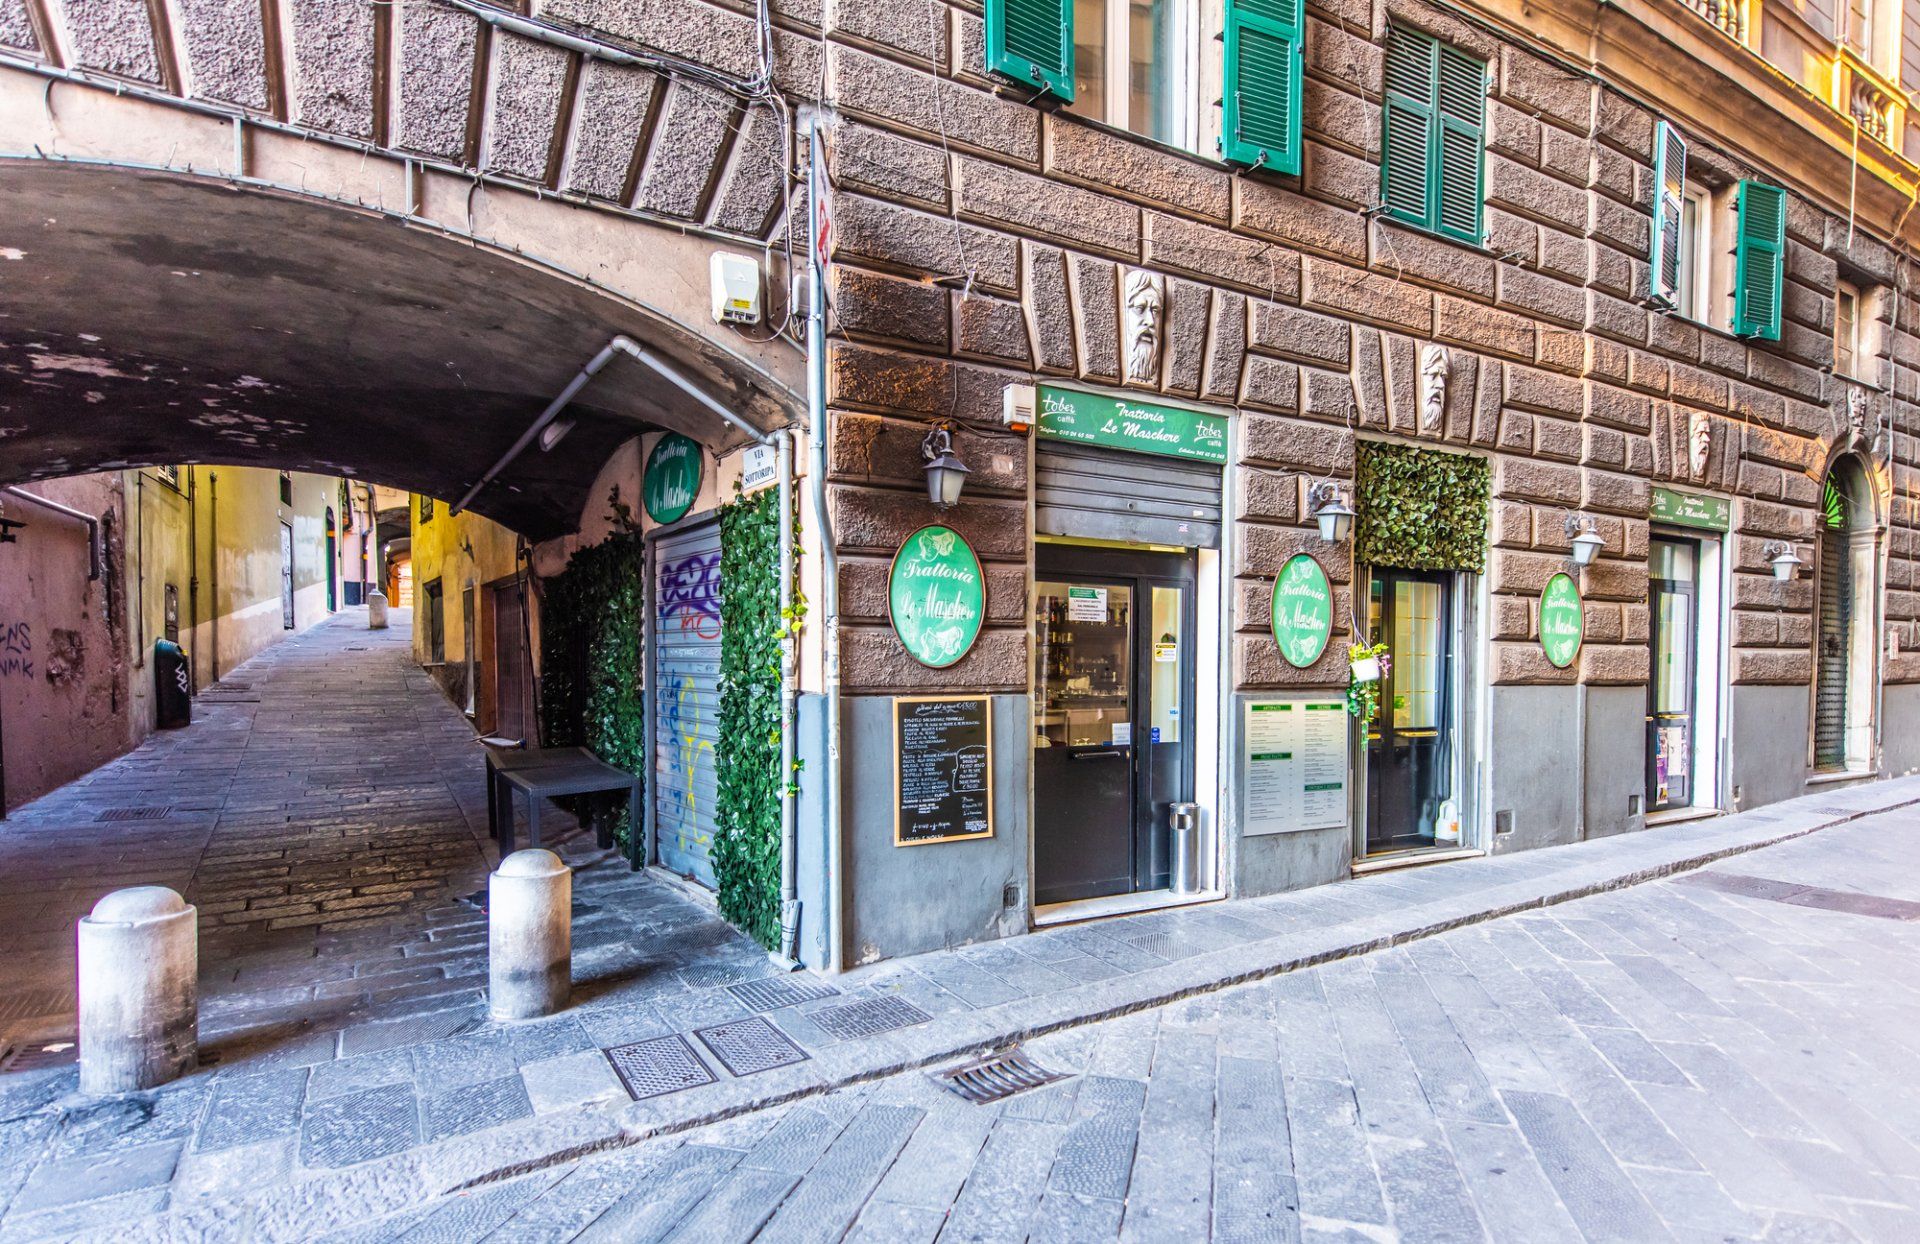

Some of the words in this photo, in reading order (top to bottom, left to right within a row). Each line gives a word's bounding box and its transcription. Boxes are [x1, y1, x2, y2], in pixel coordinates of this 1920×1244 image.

[1042, 393, 1076, 414] tober
[1115, 402, 1165, 423] Trattoria
[1100, 418, 1118, 434] Le
[1122, 422, 1180, 443] Maschere
[654, 440, 688, 468] Trattoria
[754, 449, 764, 460] VIA
[745, 466, 774, 484] SOTTORIPA
[903, 558, 975, 584] Trattoria
[900, 591, 916, 618] Le
[918, 582, 976, 620] Maschere
[1280, 581, 1326, 601] Trattoria
